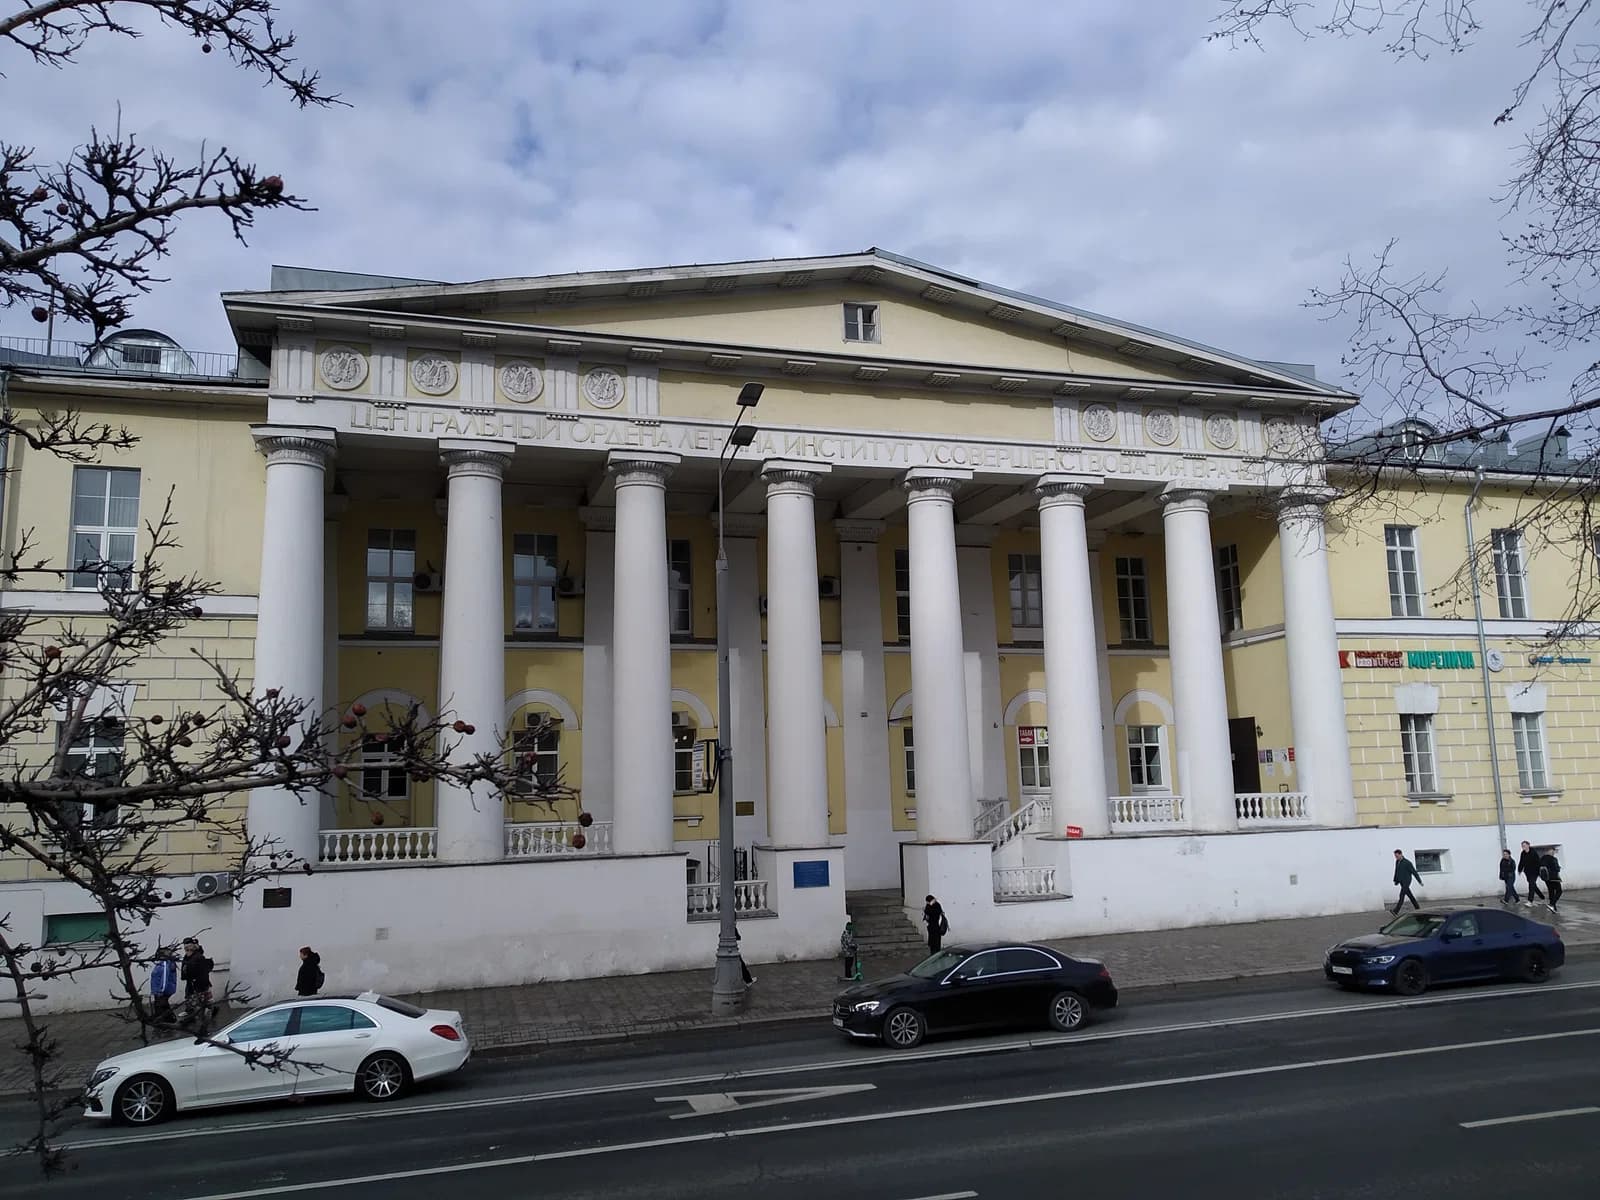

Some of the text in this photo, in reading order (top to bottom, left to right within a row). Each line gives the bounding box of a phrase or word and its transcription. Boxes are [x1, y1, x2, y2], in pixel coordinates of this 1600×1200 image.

[350, 403, 562, 442] ЦЕНТРАЛЬНЫЙ
[568, 422, 673, 448] ОРДЕНА
[783, 434, 911, 463] ИНСТИТУТ
[920, 443, 1185, 477] УСОВЕРШЕНСТВОВАНИЯ
